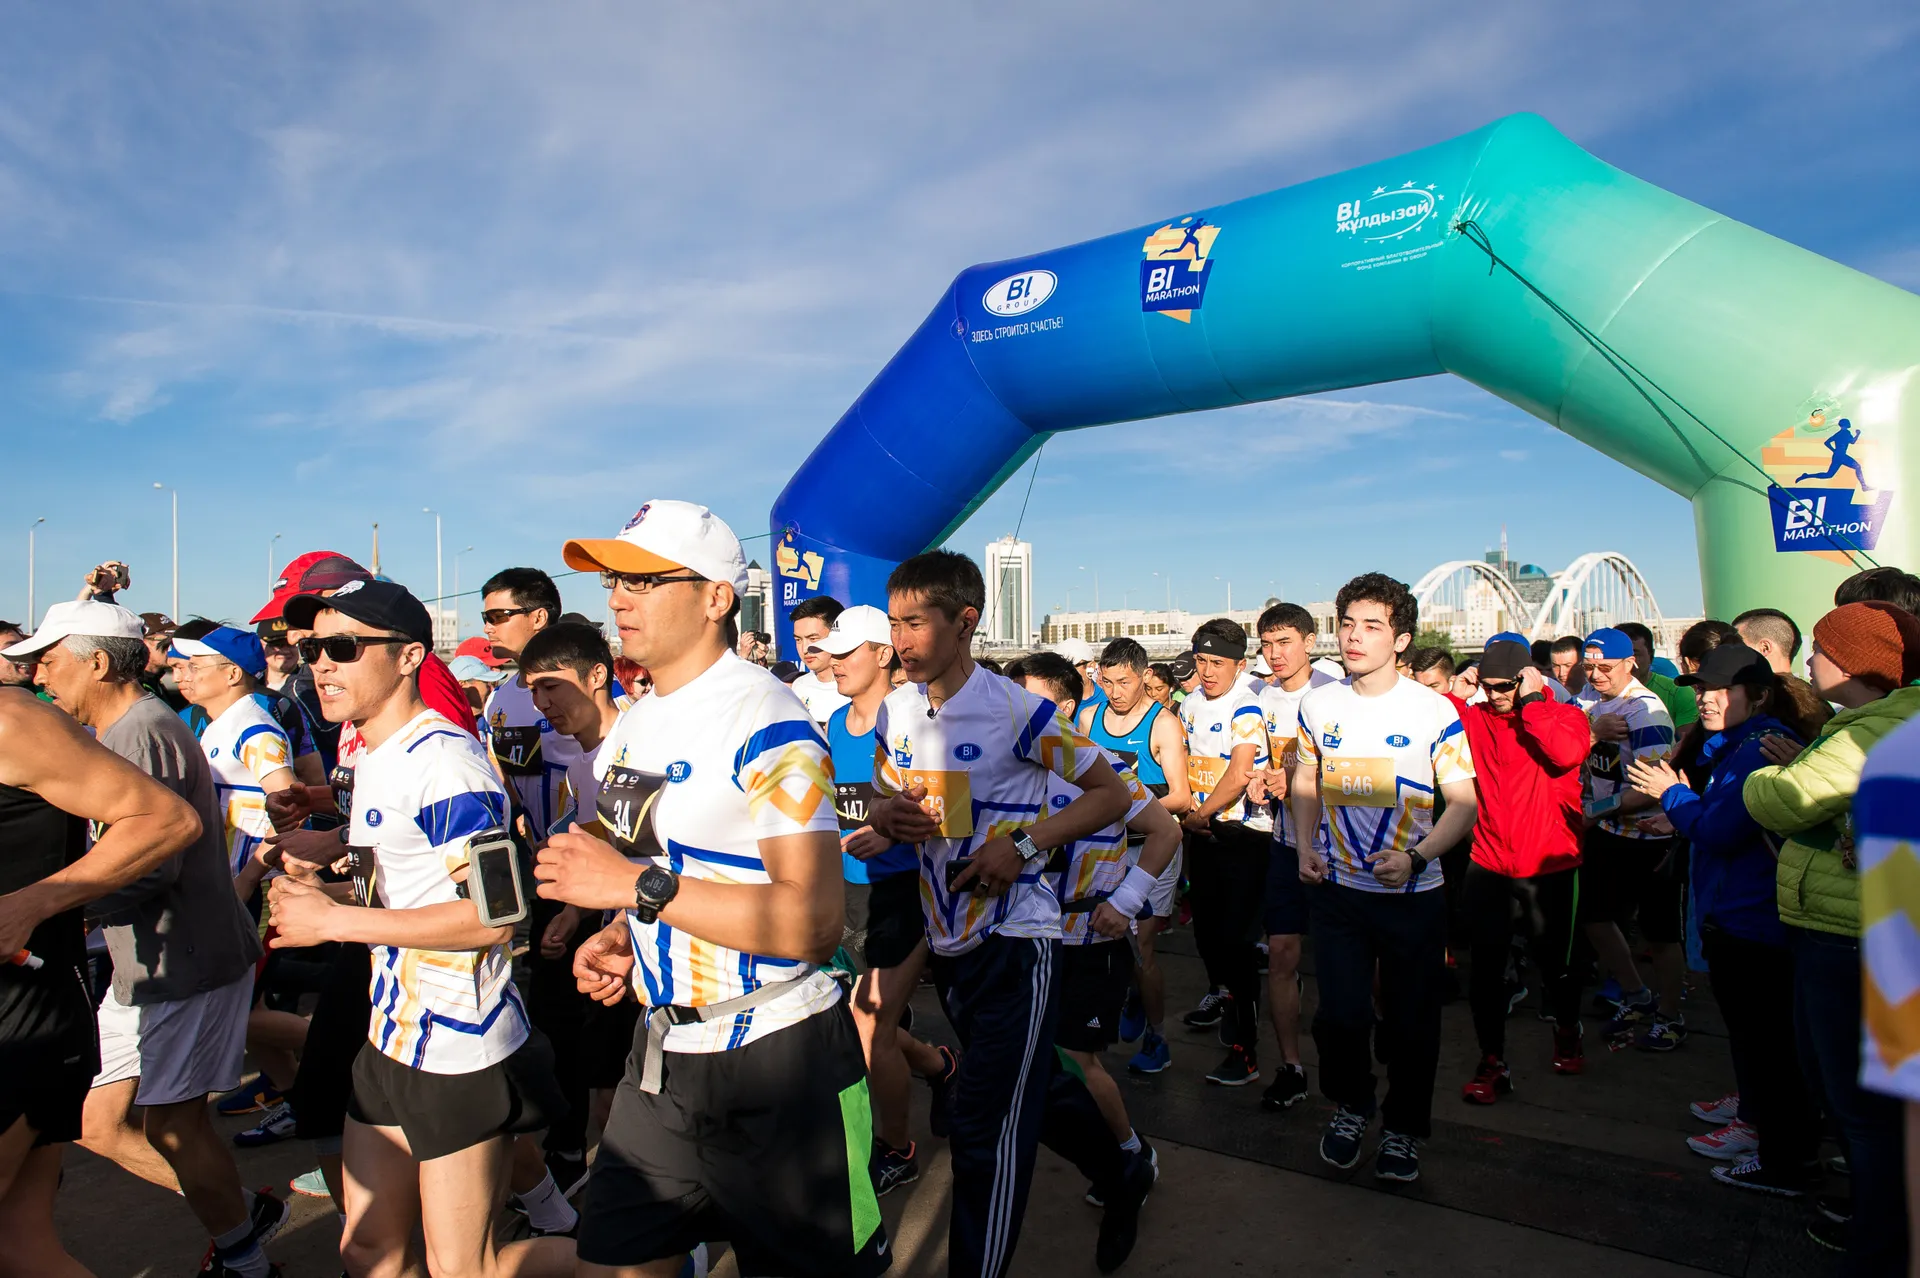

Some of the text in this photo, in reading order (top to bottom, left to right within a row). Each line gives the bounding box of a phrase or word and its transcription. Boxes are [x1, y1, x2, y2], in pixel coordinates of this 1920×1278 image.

[1336, 200, 1361, 222] BI
[1147, 265, 1175, 293] BI
[1145, 284, 1200, 303] MARATHON
[996, 298, 1038, 311] GROUP
[971, 316, 1064, 343] ЗДЕСЬ СТРОИТСЯ СЧАСТЬЕ!
[1785, 496, 1827, 530] BI
[1783, 520, 1872, 542] MARATHON
[784, 582, 797, 600] BI
[509, 745, 523, 766] 47
[1198, 770, 1215, 787] 275
[1341, 775, 1373, 796] 646
[613, 799, 632, 838] 34
[843, 800, 864, 820] 147
